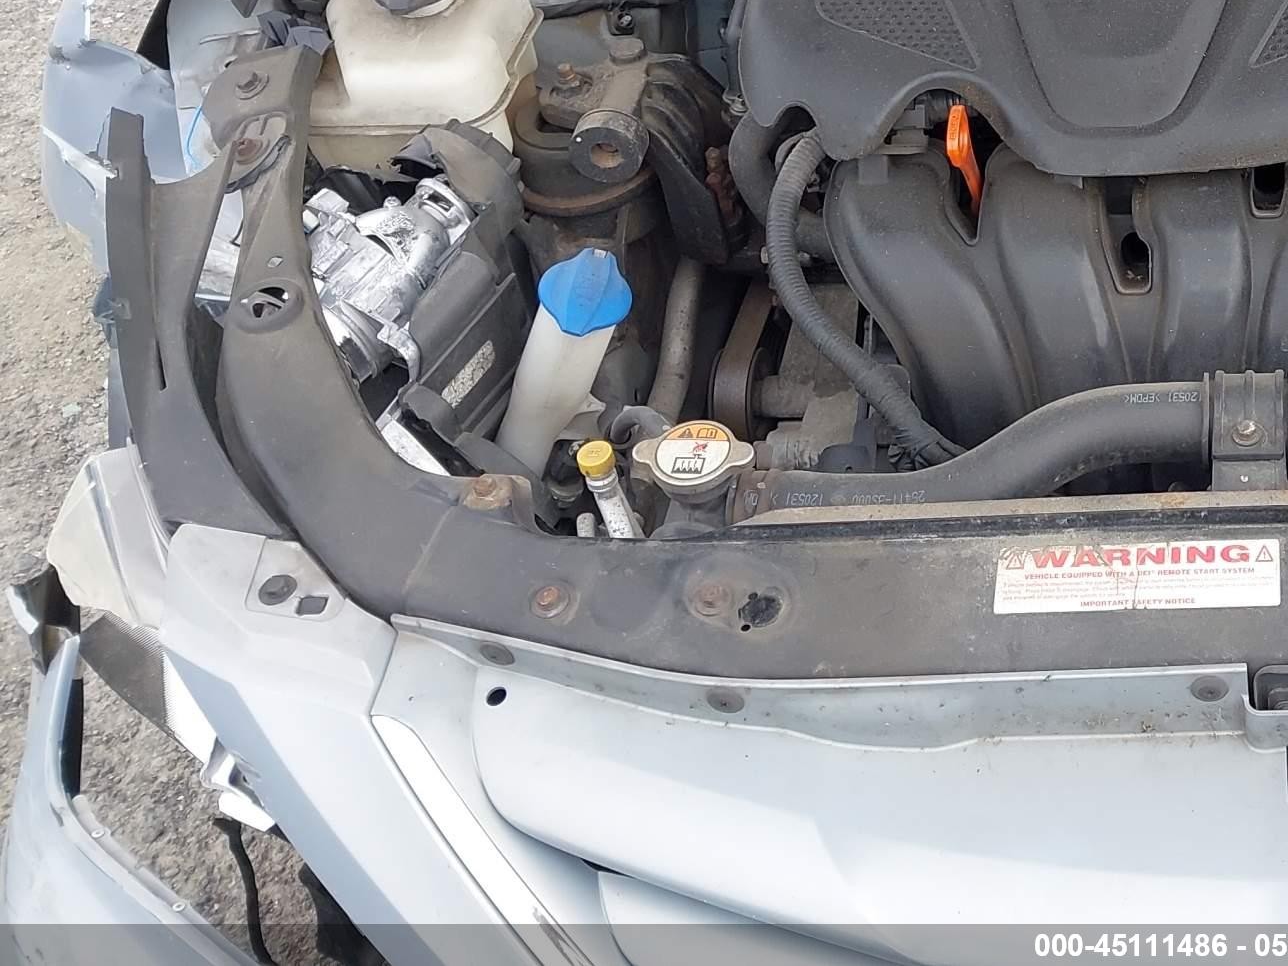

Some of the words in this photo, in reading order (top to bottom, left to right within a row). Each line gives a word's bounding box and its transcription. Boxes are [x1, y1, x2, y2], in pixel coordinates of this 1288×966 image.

[1030, 544, 1251, 568] WARNING
[1061, 571, 1103, 579] EQUIPPED
[1105, 570, 1127, 578] WITH
[1080, 600, 1129, 608] IMPORTANT
[1165, 597, 1196, 605] NOTICE
